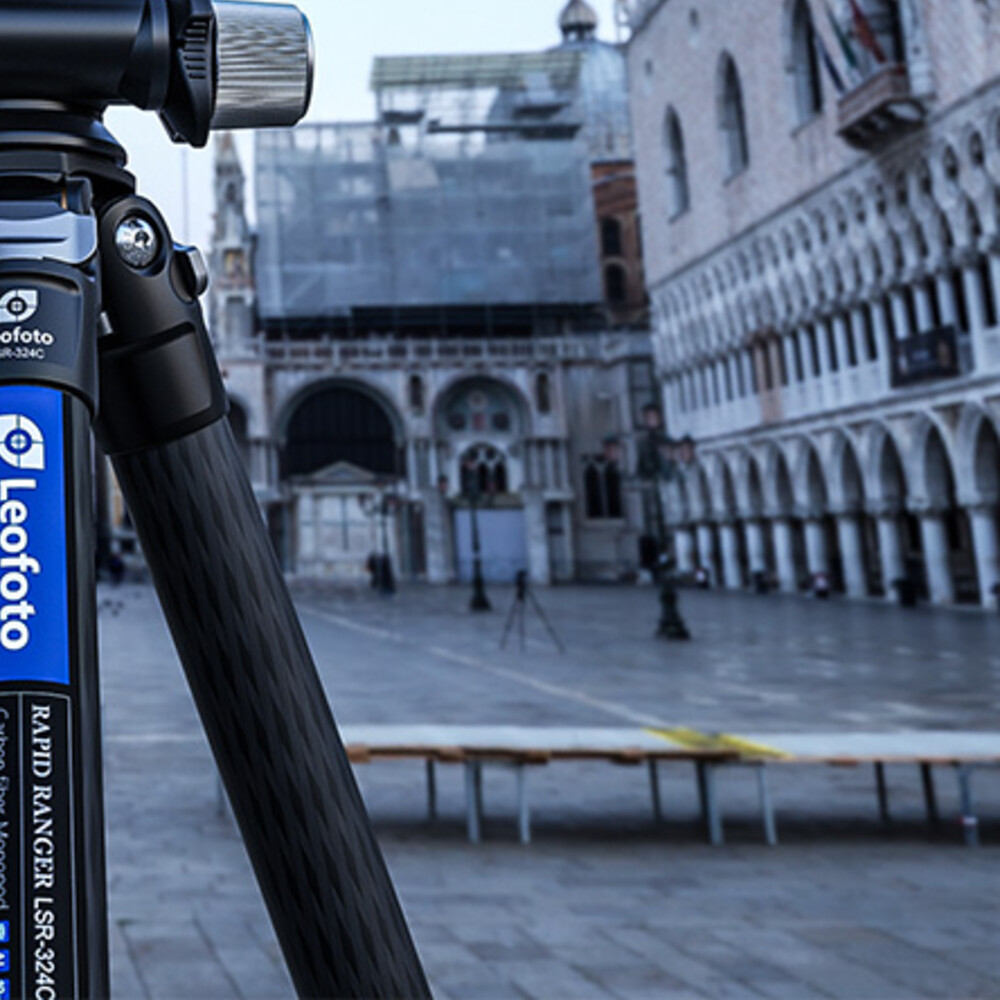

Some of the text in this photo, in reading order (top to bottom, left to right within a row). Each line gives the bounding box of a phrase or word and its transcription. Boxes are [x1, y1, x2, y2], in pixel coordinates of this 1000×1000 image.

[0, 478, 41, 651] Leofoto
[31, 704, 56, 1000] RAPID RANGER LSR-324C
